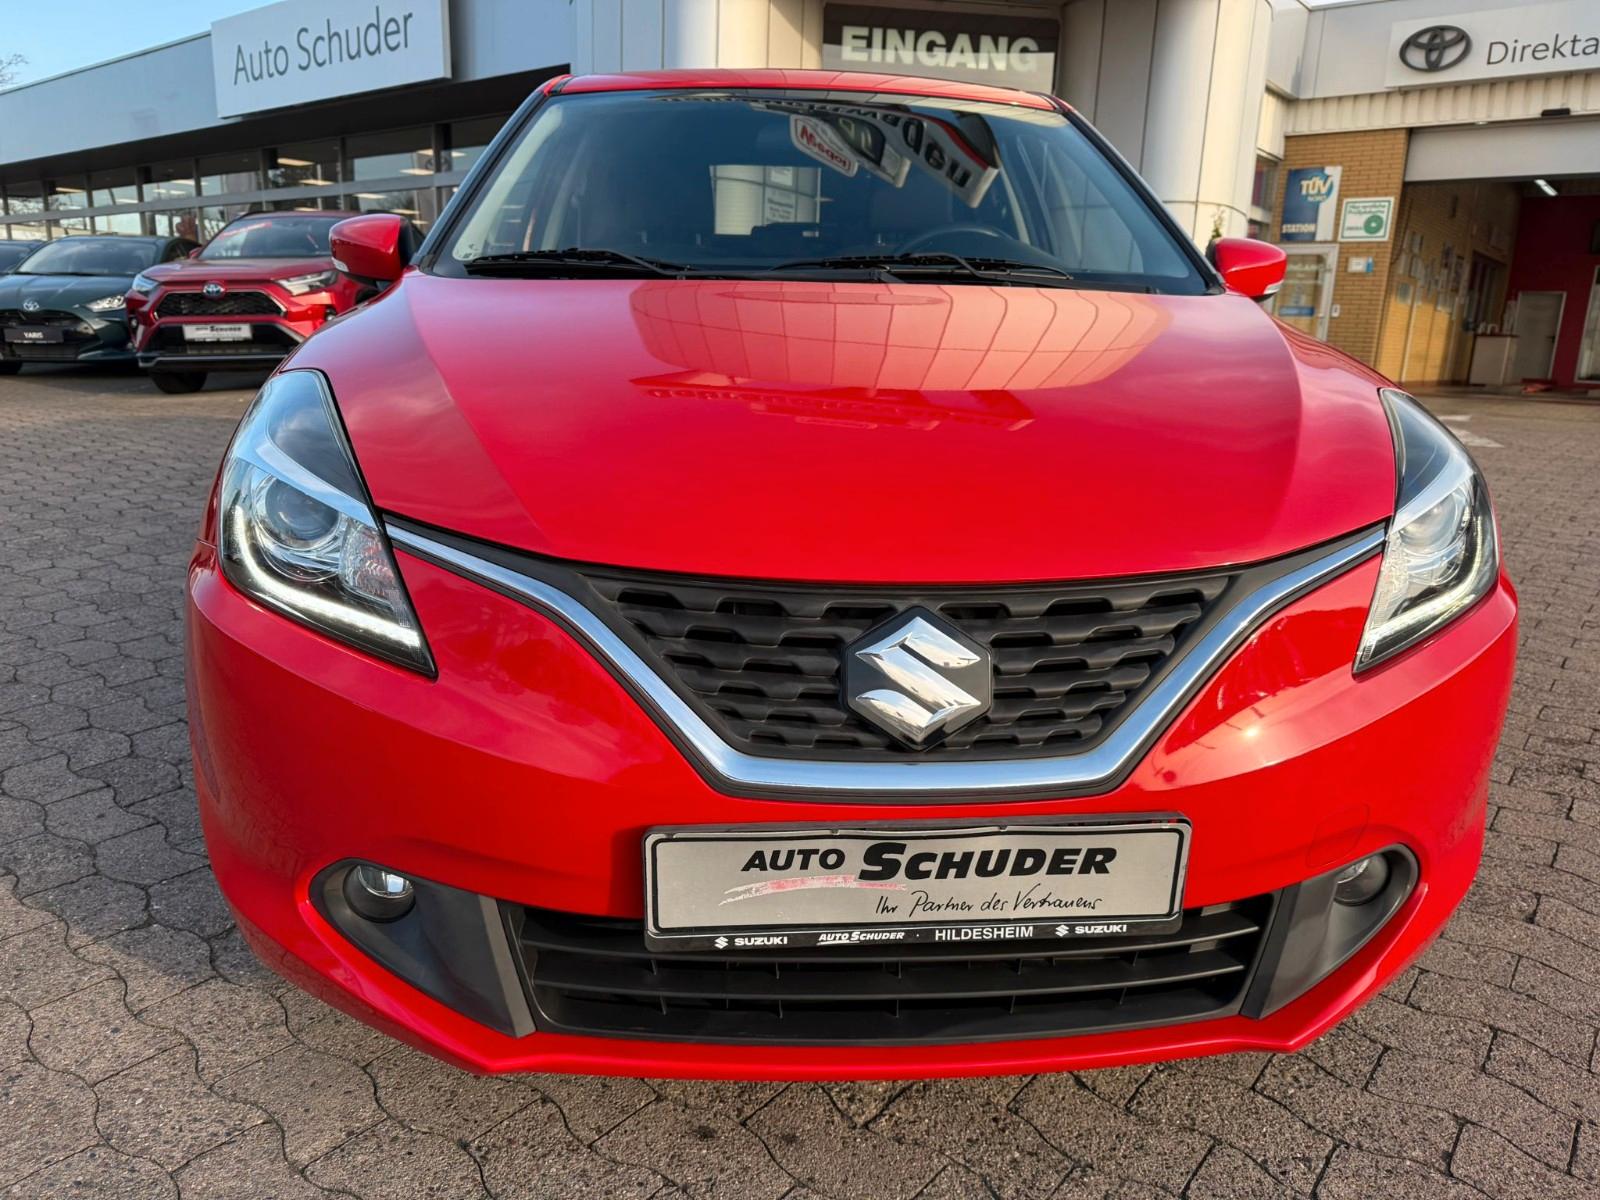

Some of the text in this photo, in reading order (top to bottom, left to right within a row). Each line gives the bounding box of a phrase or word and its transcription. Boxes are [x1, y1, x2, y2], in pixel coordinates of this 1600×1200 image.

[234, 5, 413, 86] Auto Schuder
[841, 25, 1039, 72] EINGANG
[1300, 175, 1333, 195] TÜV
[741, 842, 1117, 881] AUTO SCHUDER
[875, 883, 1103, 918] Ihr Partner des Vertrauens
[734, 936, 788, 946] SUZUKI
[935, 926, 1033, 941] HILDESHEIM
[1074, 924, 1128, 935] SUZUKI
